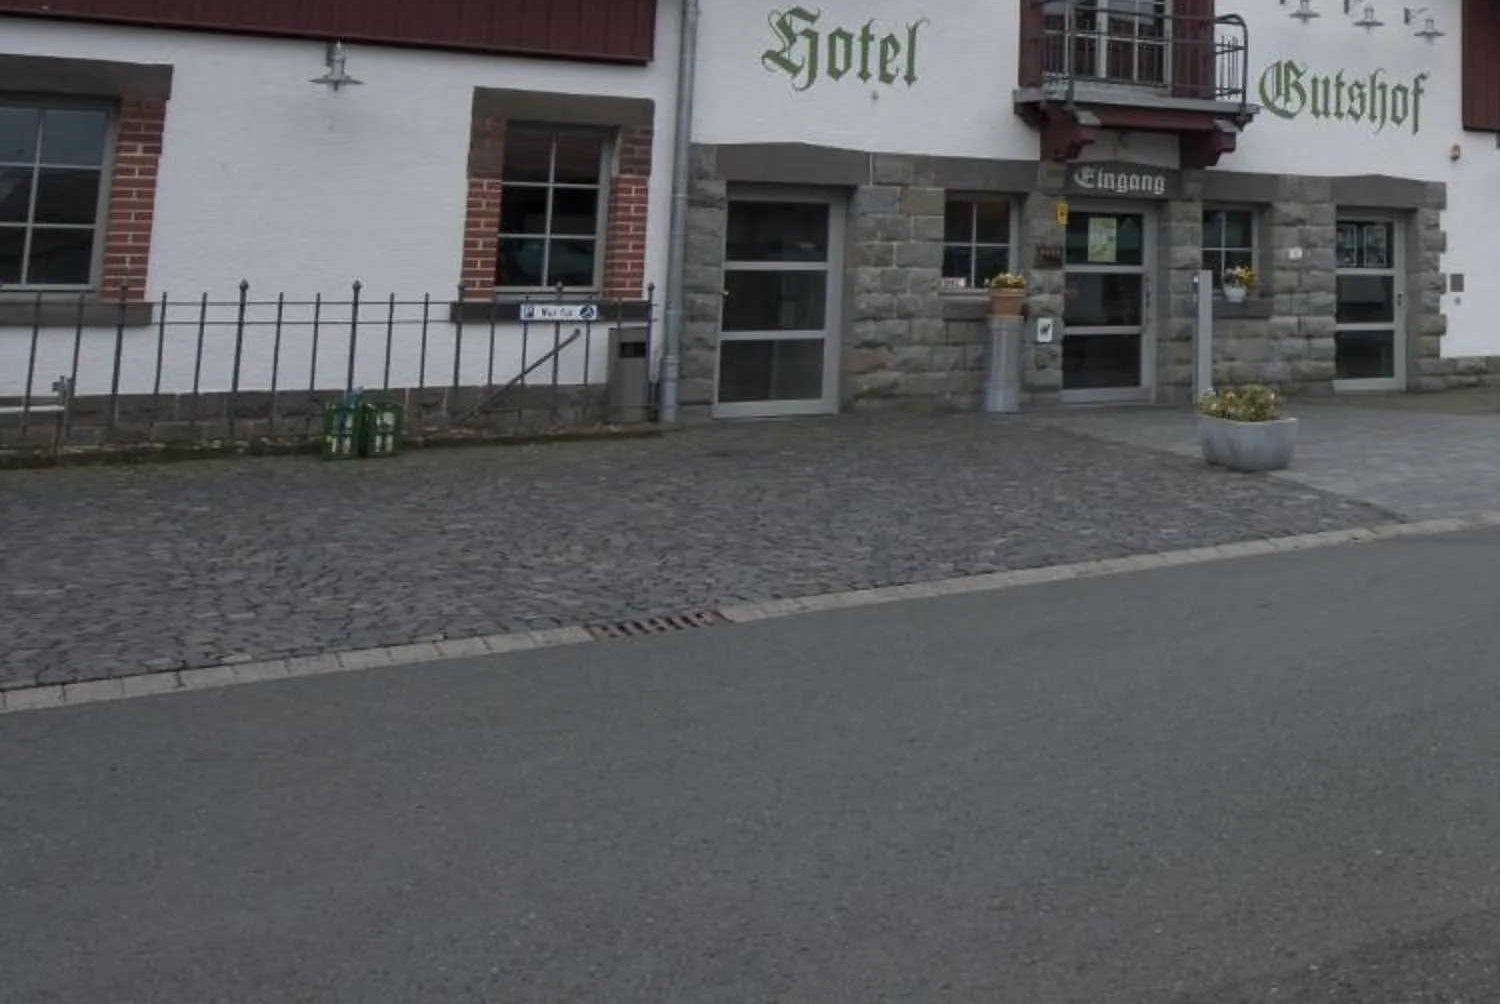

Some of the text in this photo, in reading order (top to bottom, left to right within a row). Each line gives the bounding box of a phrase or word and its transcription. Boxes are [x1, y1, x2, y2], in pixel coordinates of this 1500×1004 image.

[762, 6, 1430, 135] Hotel Gutshof
[1073, 165, 1166, 194] Eingang
